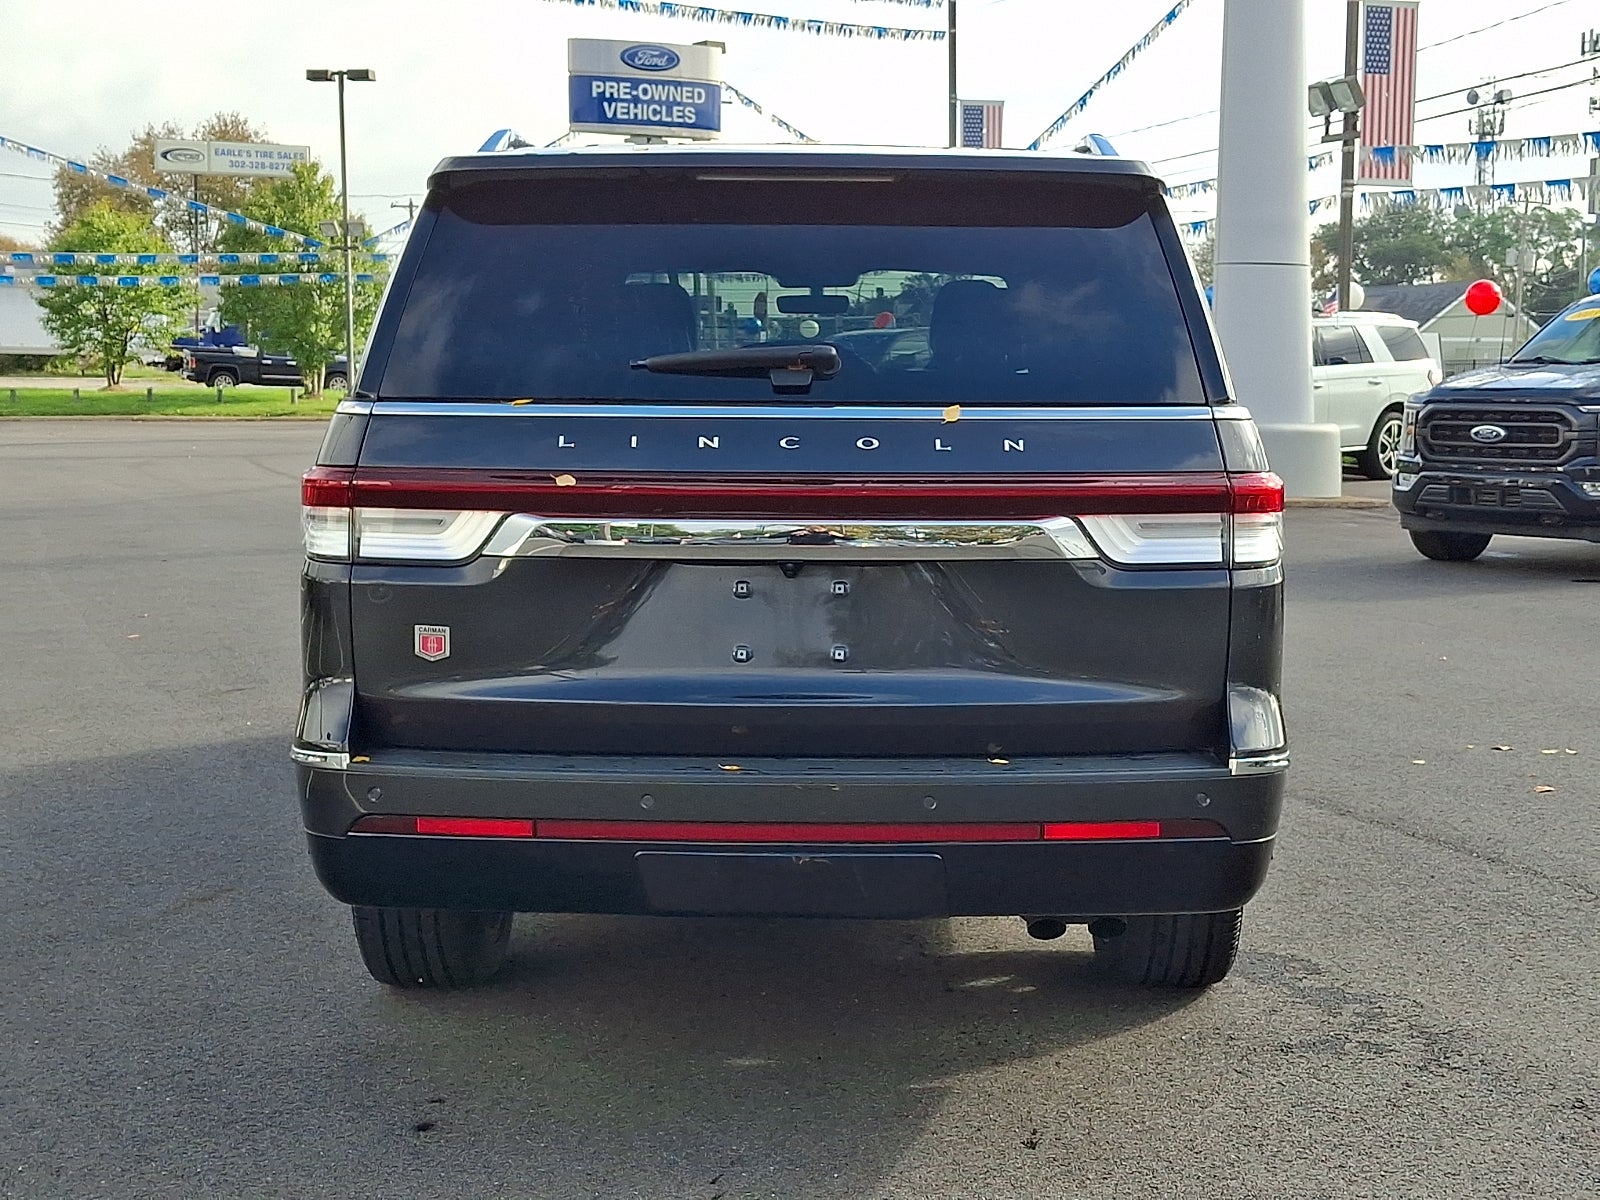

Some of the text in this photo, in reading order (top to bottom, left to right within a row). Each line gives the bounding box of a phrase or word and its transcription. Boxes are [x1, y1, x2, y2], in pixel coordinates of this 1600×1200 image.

[634, 51, 669, 67] Ford
[591, 81, 706, 104] PRE-OWNED
[602, 101, 697, 124] VEHICLES
[214, 148, 305, 161] EARLE'S TIRE SALES
[557, 434, 1025, 453] LINCOLN
